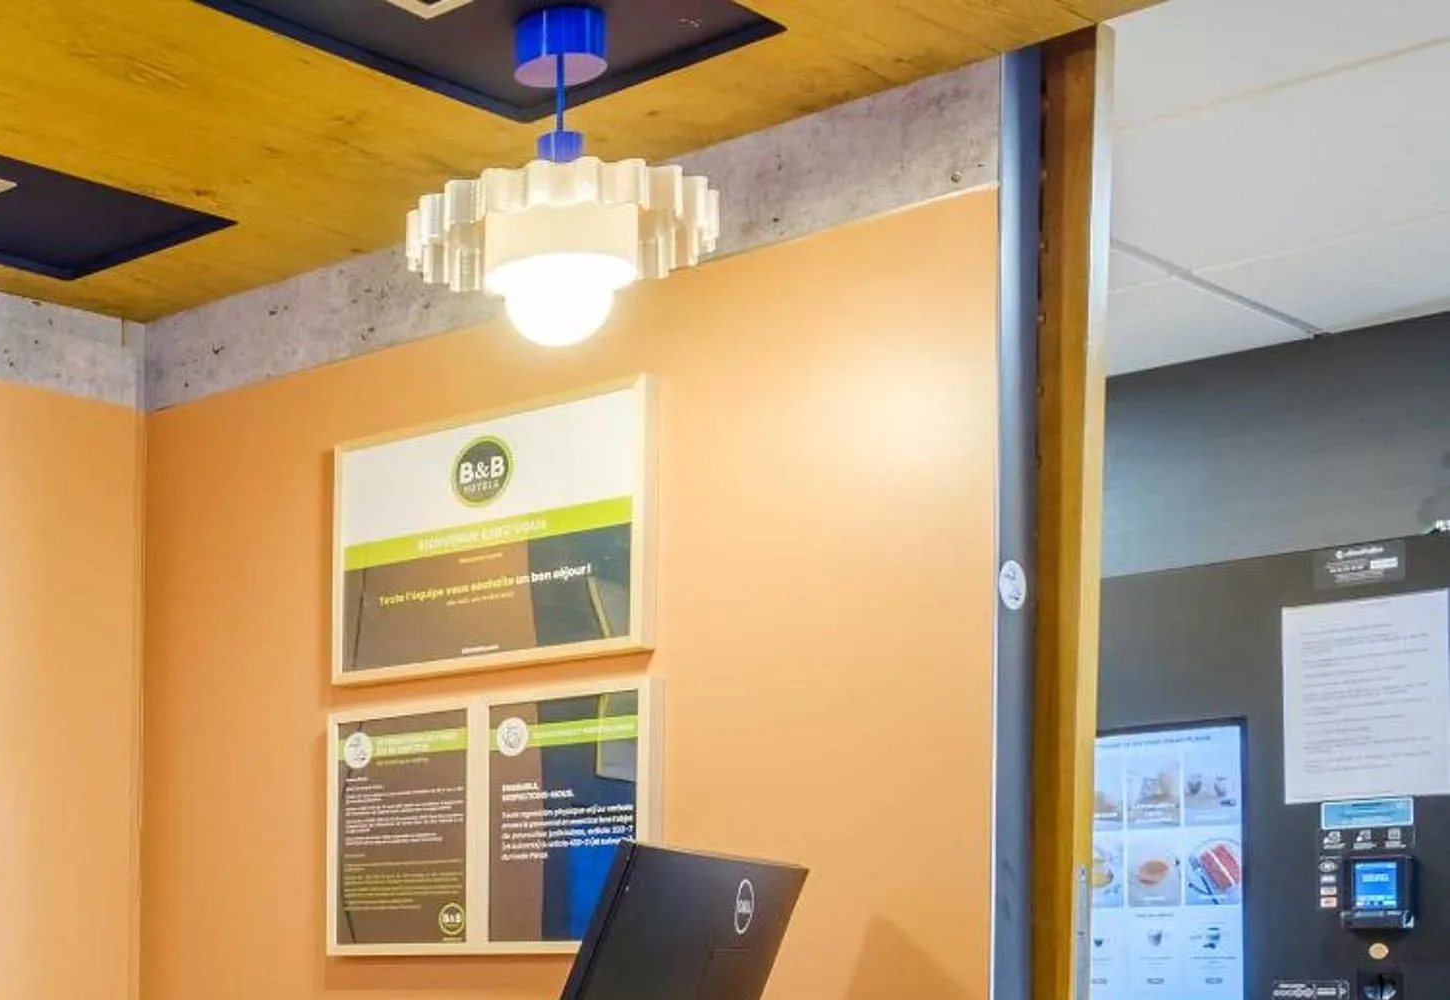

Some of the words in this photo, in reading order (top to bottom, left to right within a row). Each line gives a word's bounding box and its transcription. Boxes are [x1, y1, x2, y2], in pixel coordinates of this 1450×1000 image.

[460, 455, 505, 484] B&B
[531, 571, 551, 583] bon
[553, 565, 586, 581] séjour
